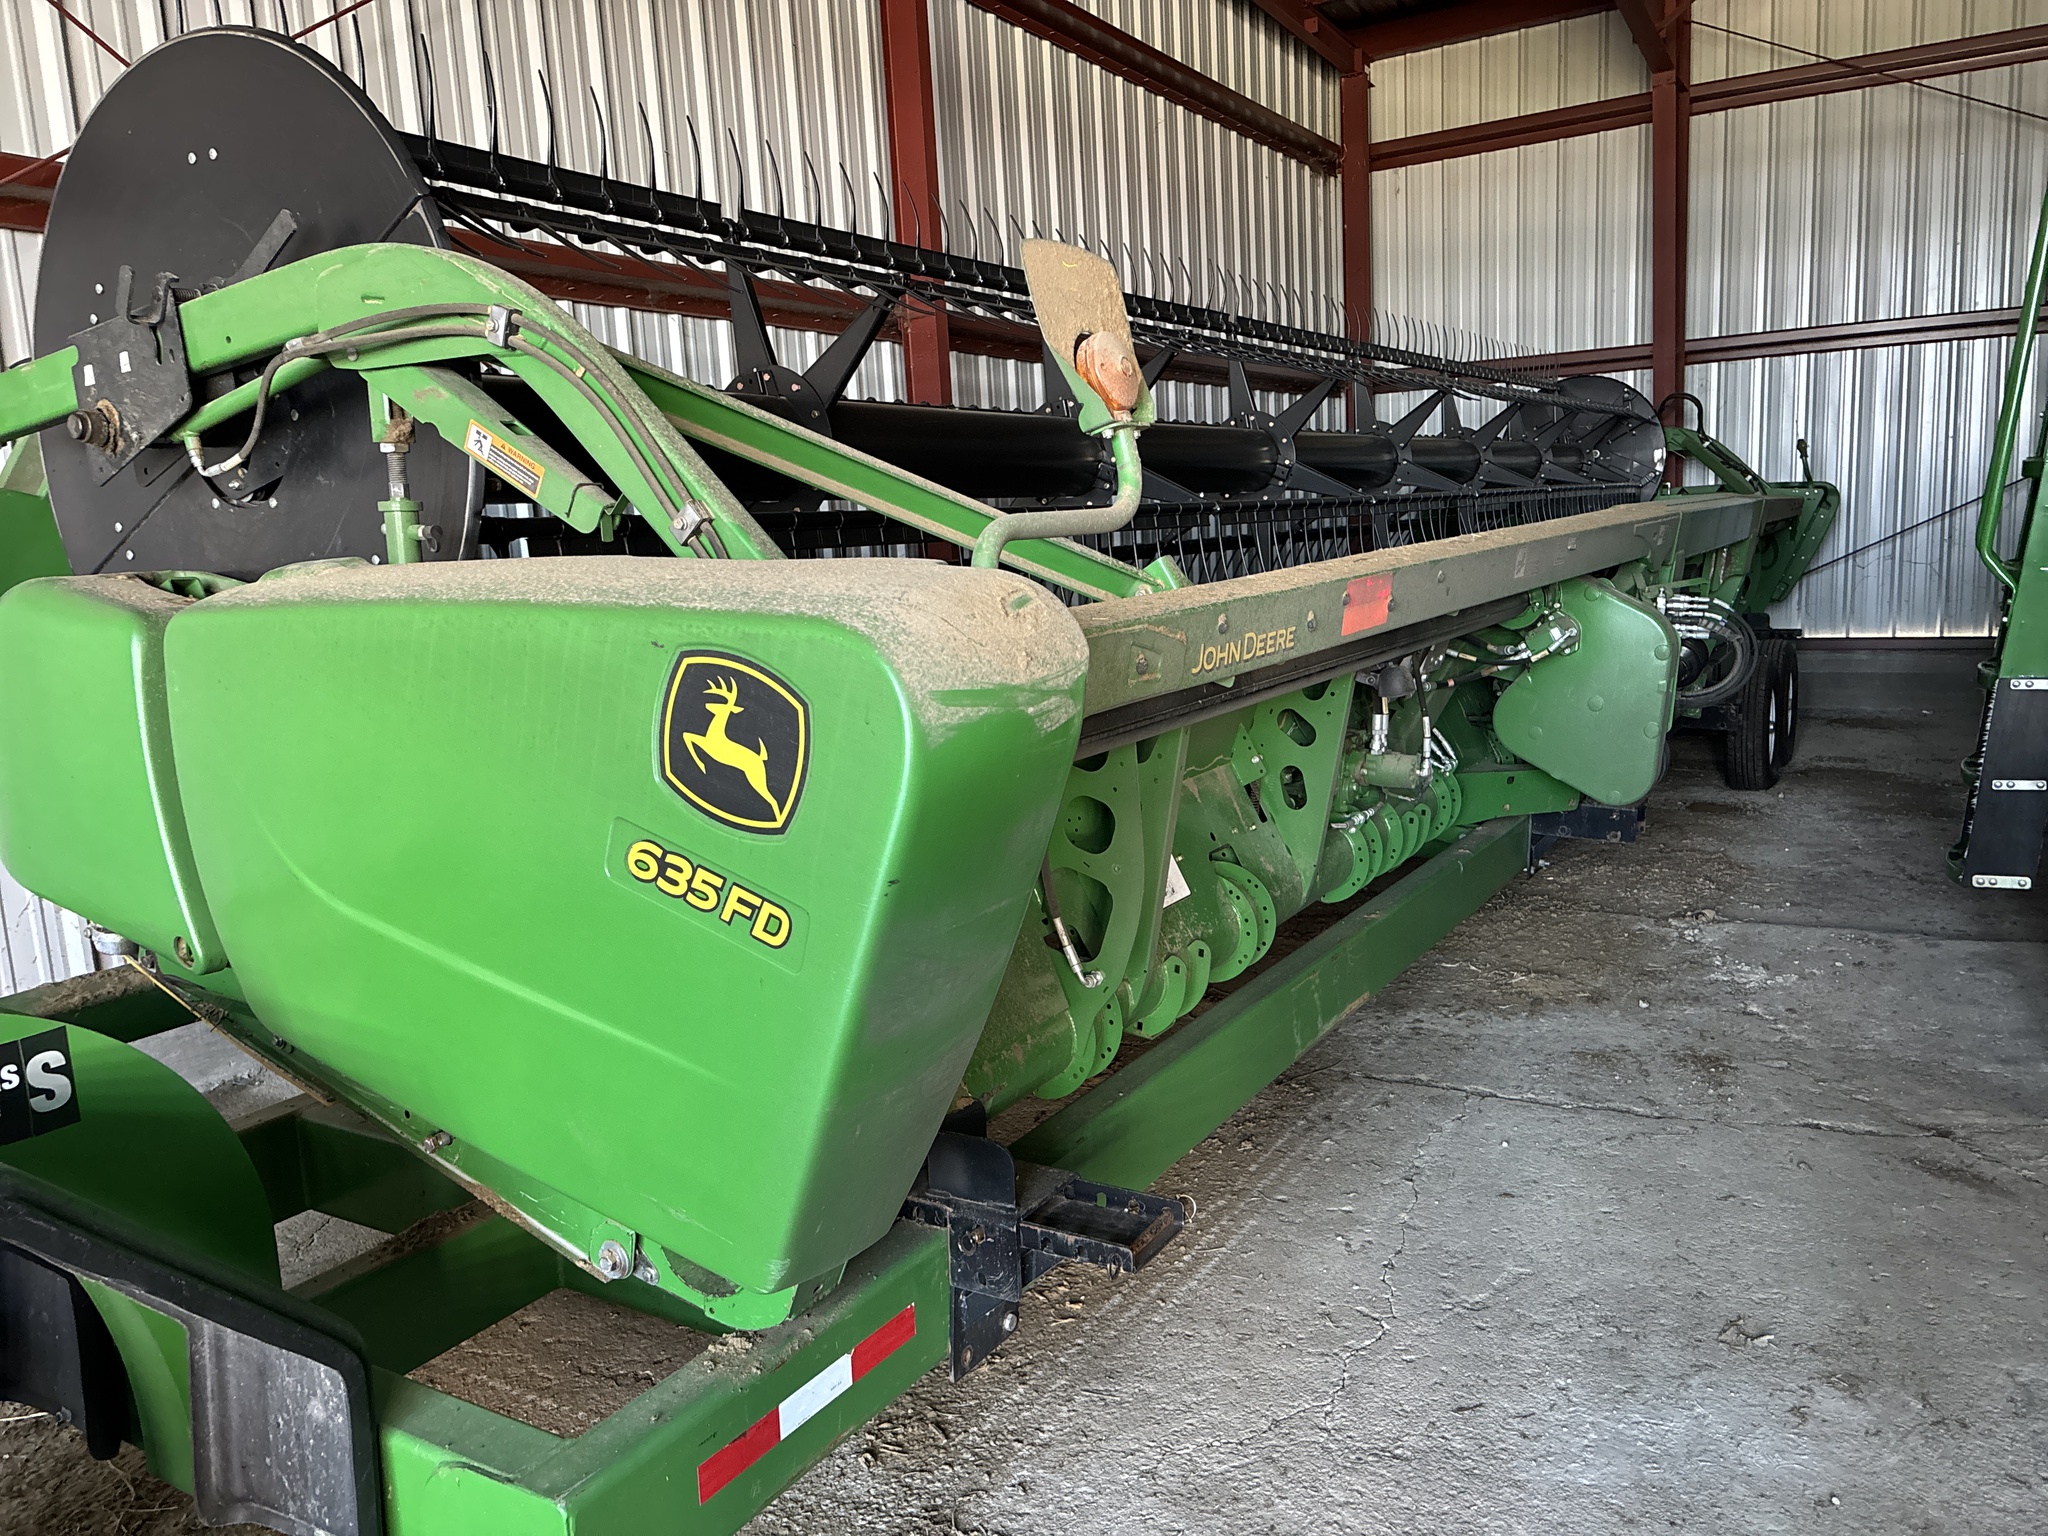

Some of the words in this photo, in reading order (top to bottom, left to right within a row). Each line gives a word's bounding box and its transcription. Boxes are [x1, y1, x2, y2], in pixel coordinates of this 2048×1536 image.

[508, 446, 536, 470] WARNING
[1191, 639, 1242, 675] JOHN
[1243, 626, 1296, 661] DEERE
[625, 839, 792, 949] 635FD
